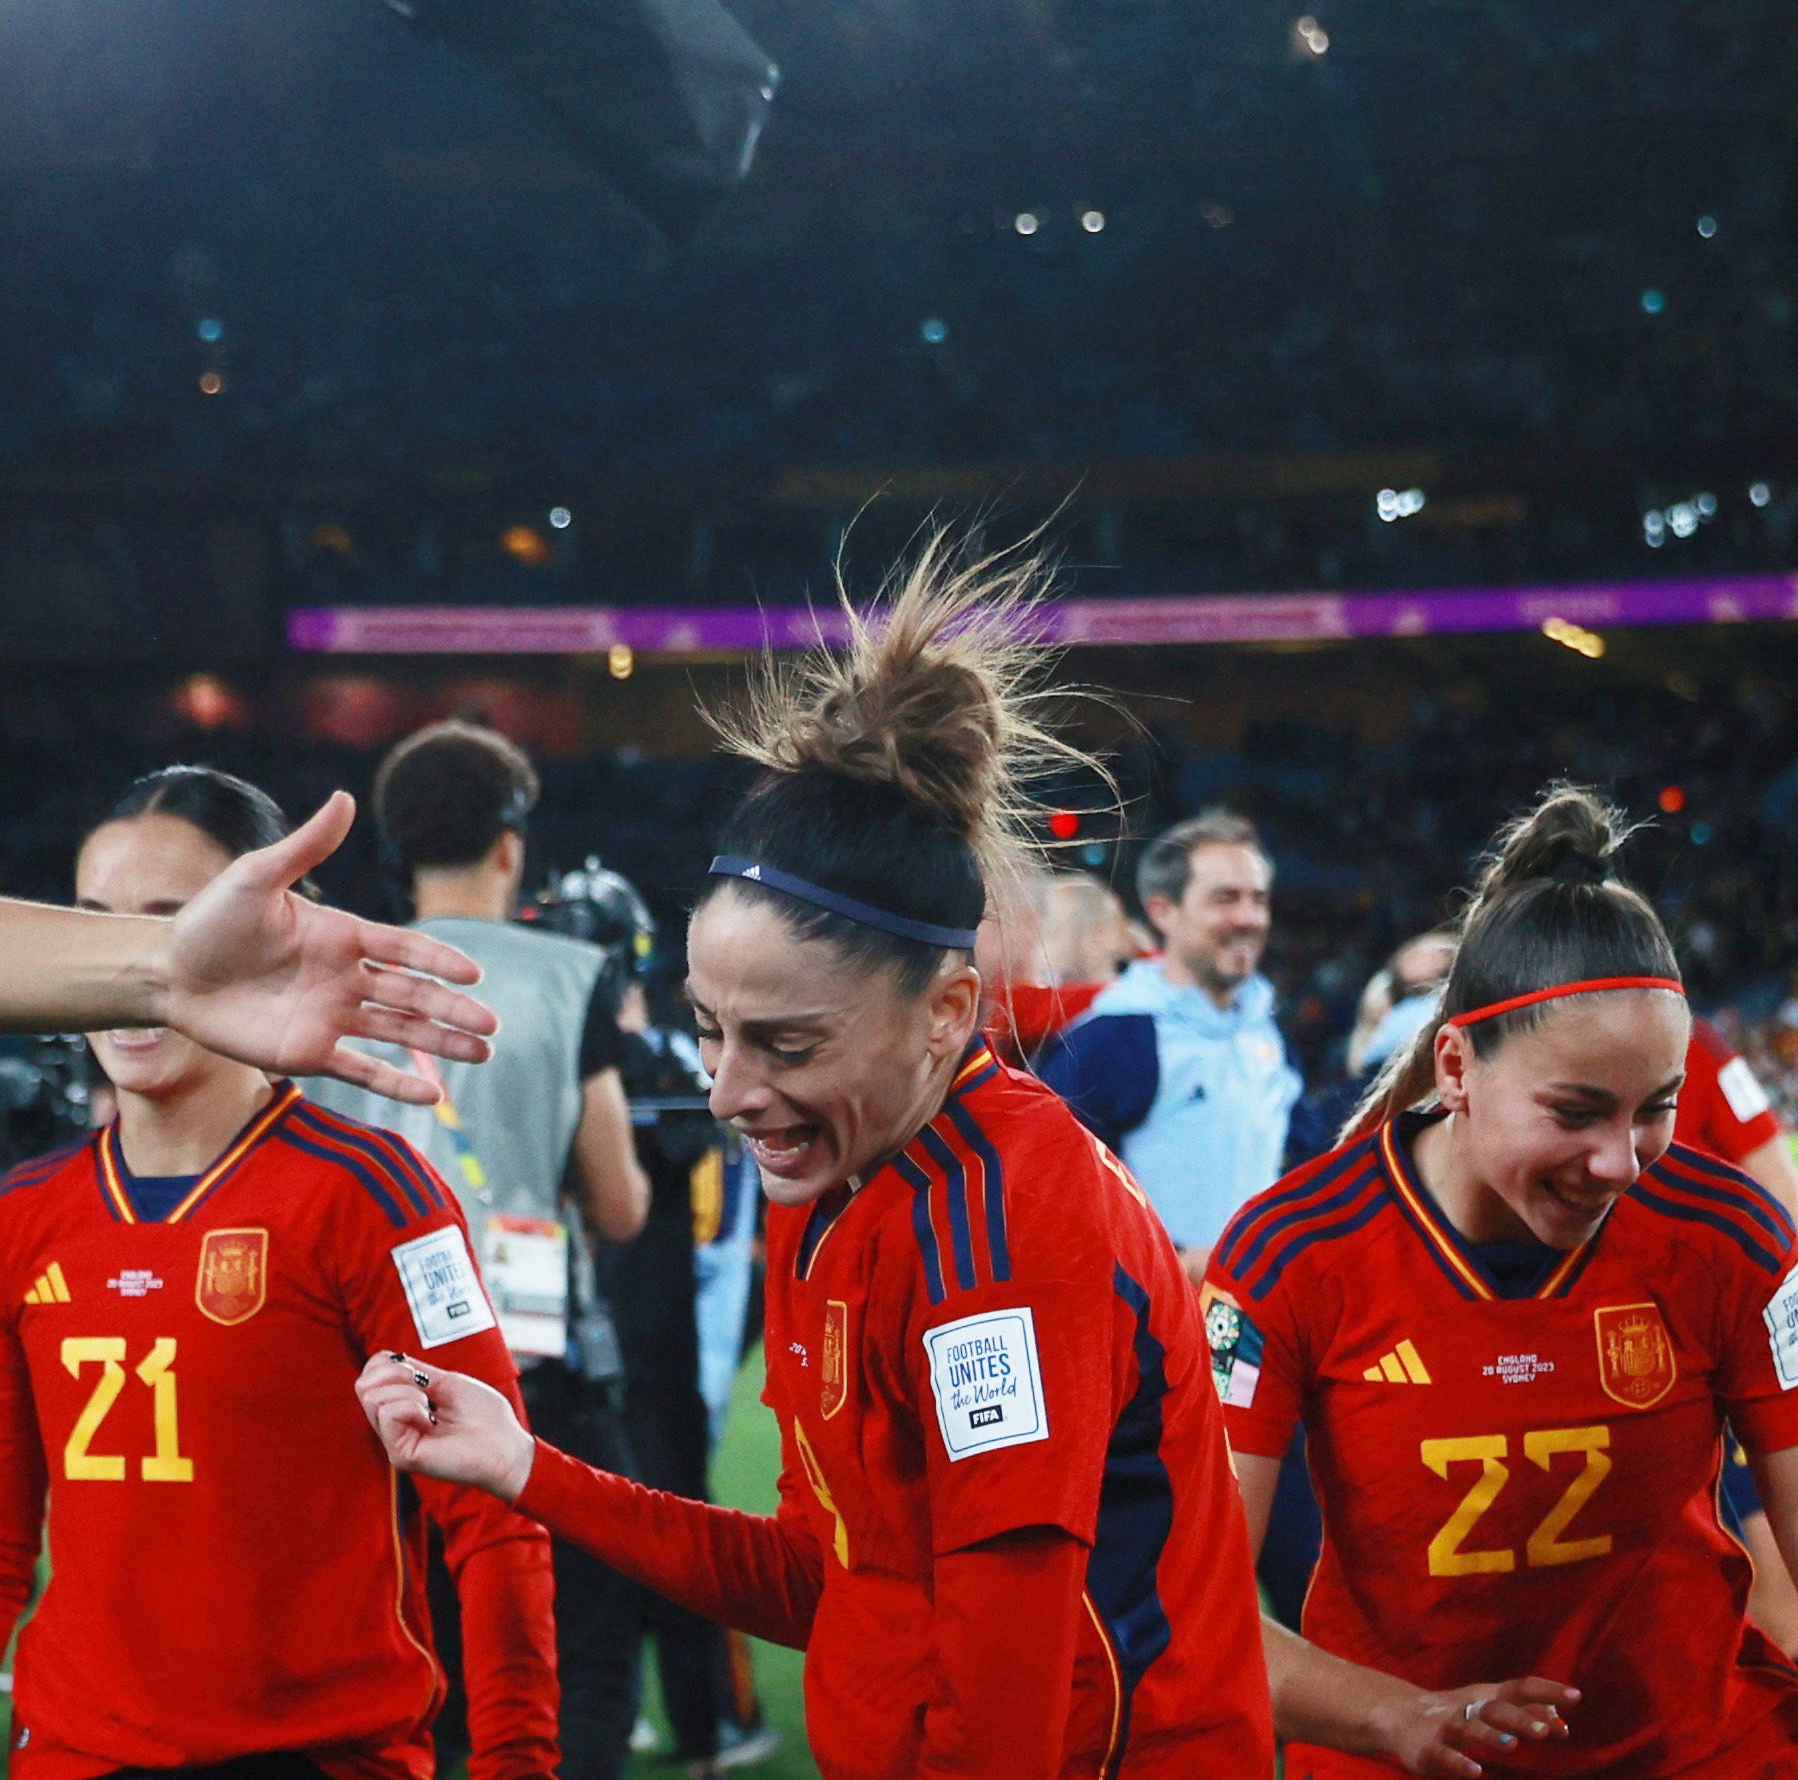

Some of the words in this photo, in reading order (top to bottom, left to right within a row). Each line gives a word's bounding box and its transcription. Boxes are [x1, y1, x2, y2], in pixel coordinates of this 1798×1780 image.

[947, 1335, 1008, 1364] FOOTBALL
[1497, 1354, 1538, 1365] ENGLAND
[949, 1353, 1011, 1387] UNITES
[1482, 1366, 1495, 1376] 20
[1496, 1364, 1529, 1374] AUGUST
[1532, 1362, 1555, 1372] 2023
[1502, 1373, 1536, 1385] SYDNEY
[950, 1388, 972, 1411] the
[973, 1377, 1017, 1405] World
[60, 1336, 194, 1482] 21
[972, 1408, 1001, 1426] FIFA
[1420, 1426, 1613, 1577] 22
